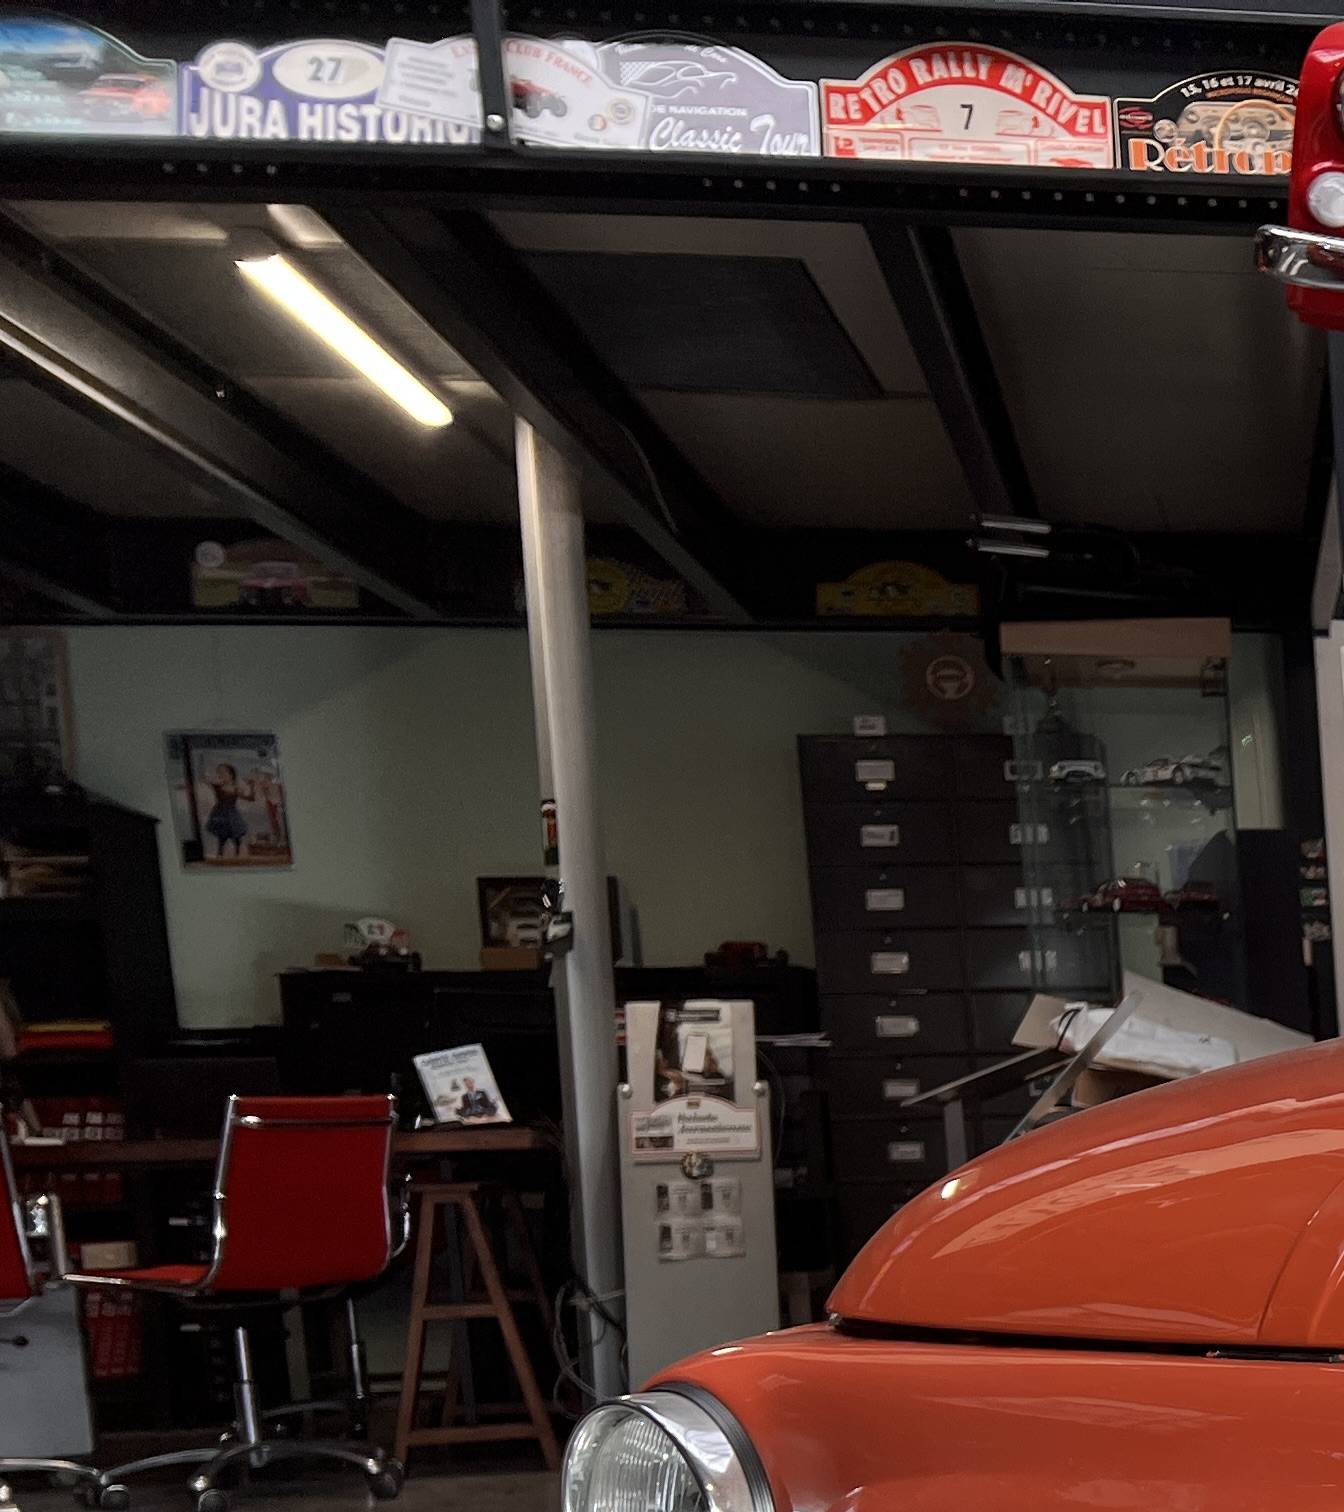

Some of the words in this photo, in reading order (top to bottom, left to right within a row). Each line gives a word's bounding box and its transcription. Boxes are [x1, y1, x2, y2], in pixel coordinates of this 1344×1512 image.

[307, 57, 343, 81] 27
[505, 40, 542, 59] CLUB
[544, 52, 593, 85] FRANCE
[1236, 75, 1253, 87] 17
[668, 105, 748, 117] NAVIGATION
[828, 68, 909, 120] RETRO
[907, 50, 994, 85] RALLY
[1031, 81, 1107, 134] RIVEL
[189, 86, 288, 139] JURA
[960, 104, 975, 130] 7
[651, 116, 742, 152] Classic
[750, 114, 810, 155] Tour
[1127, 137, 1292, 176] Rétrop
